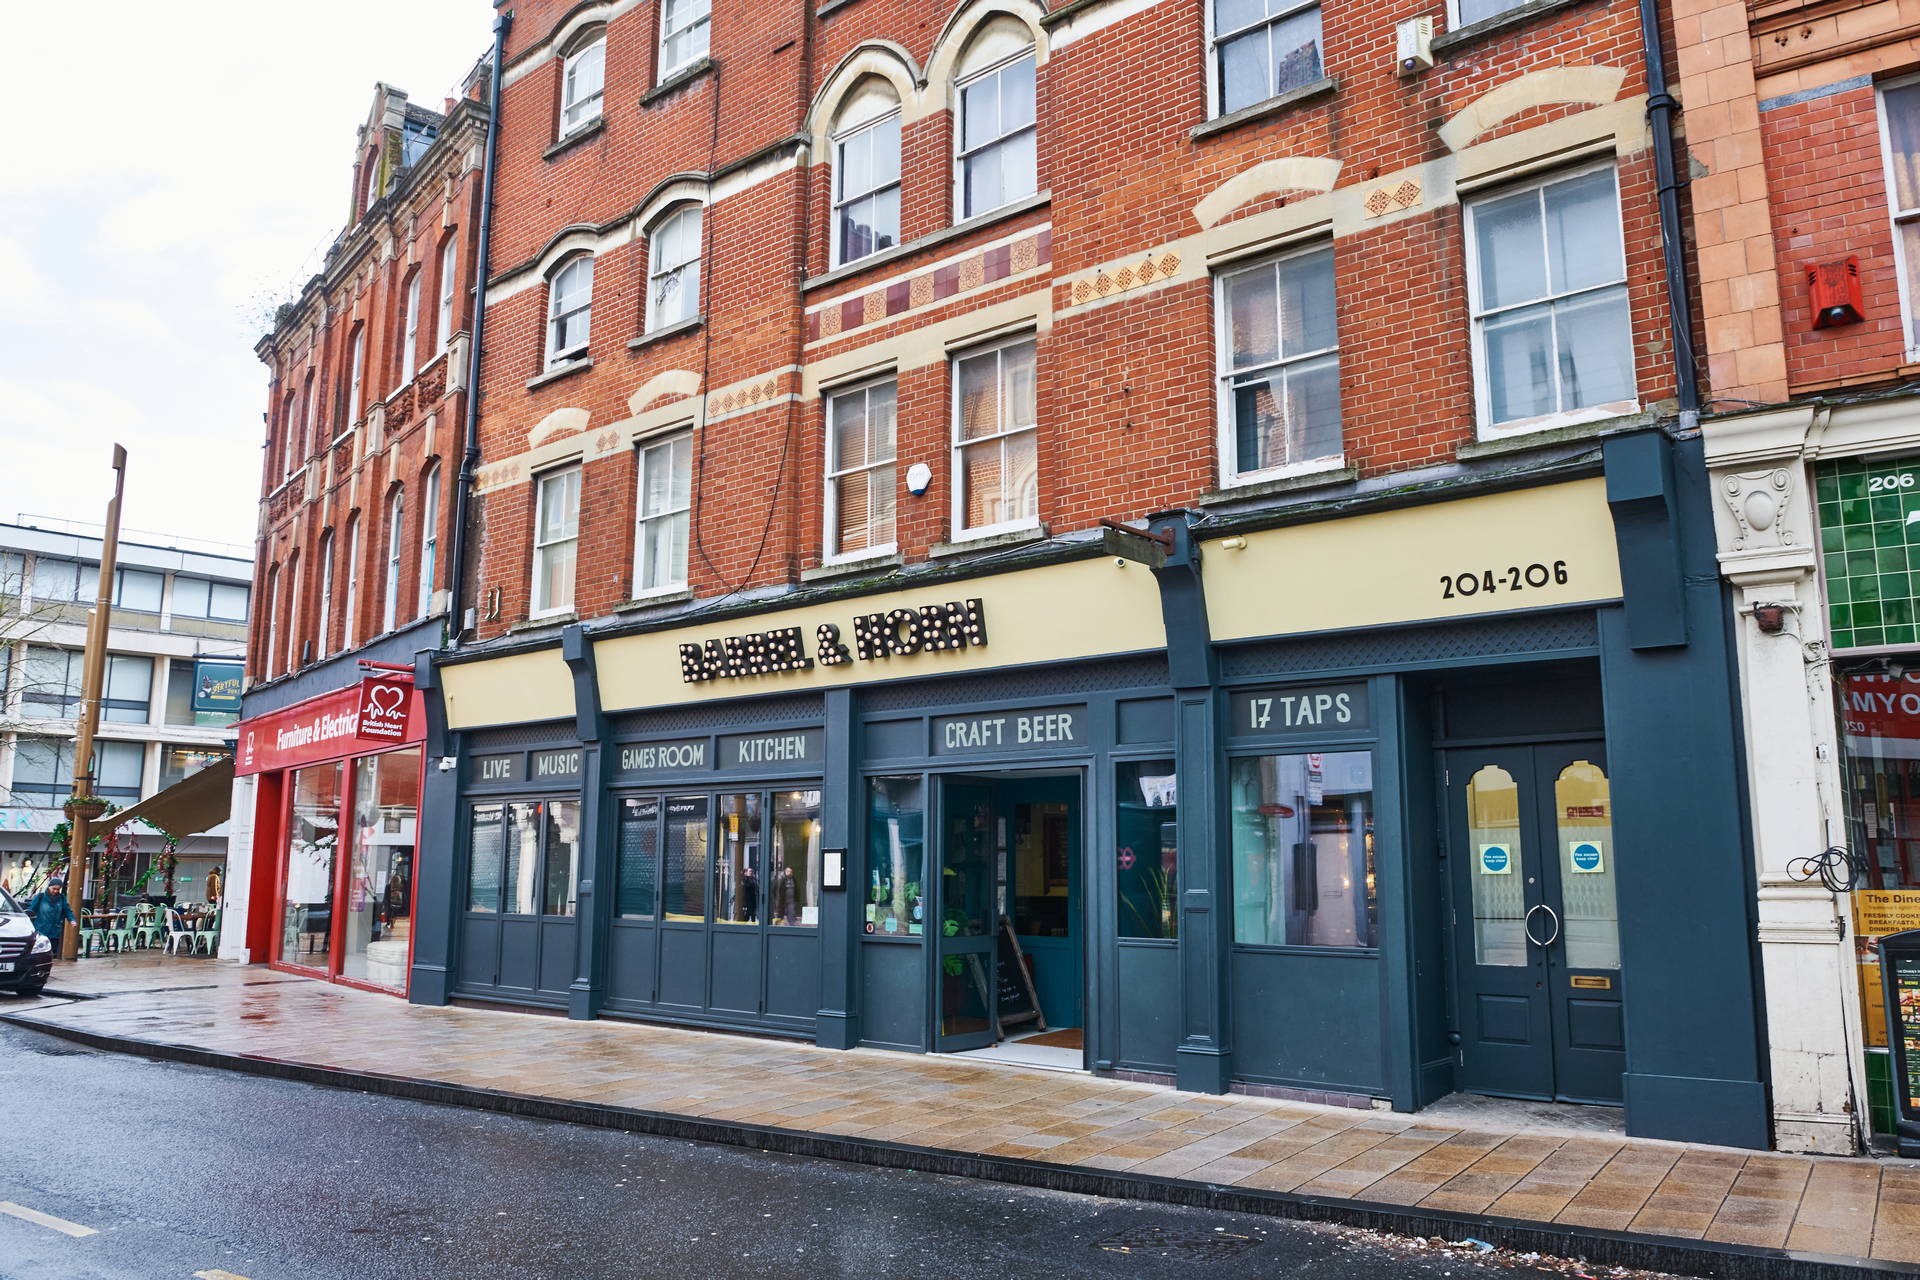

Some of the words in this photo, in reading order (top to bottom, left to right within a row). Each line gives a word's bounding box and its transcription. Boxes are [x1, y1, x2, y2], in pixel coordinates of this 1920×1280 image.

[1869, 473, 1915, 491] 206
[1440, 560, 1568, 599] 204-206
[679, 626, 814, 683] BARREL
[816, 624, 853, 666] &
[853, 598, 988, 661] HORN
[1250, 698, 1273, 729] 17
[1280, 693, 1351, 726] TAPS
[277, 724, 312, 751] Furniture
[313, 718, 320, 742] &
[362, 720, 383, 728] British
[385, 722, 402, 730] Heart
[362, 726, 402, 737] Foundation
[945, 718, 1005, 748] CRAFT
[1017, 713, 1073, 744] BEER
[622, 748, 656, 770] GAMES
[658, 744, 704, 768] ROOM
[738, 736, 806, 763] KITCHEN
[482, 759, 511, 779] LIVE
[538, 753, 579, 776] MUSIC
[1866, 895, 1889, 903] The
